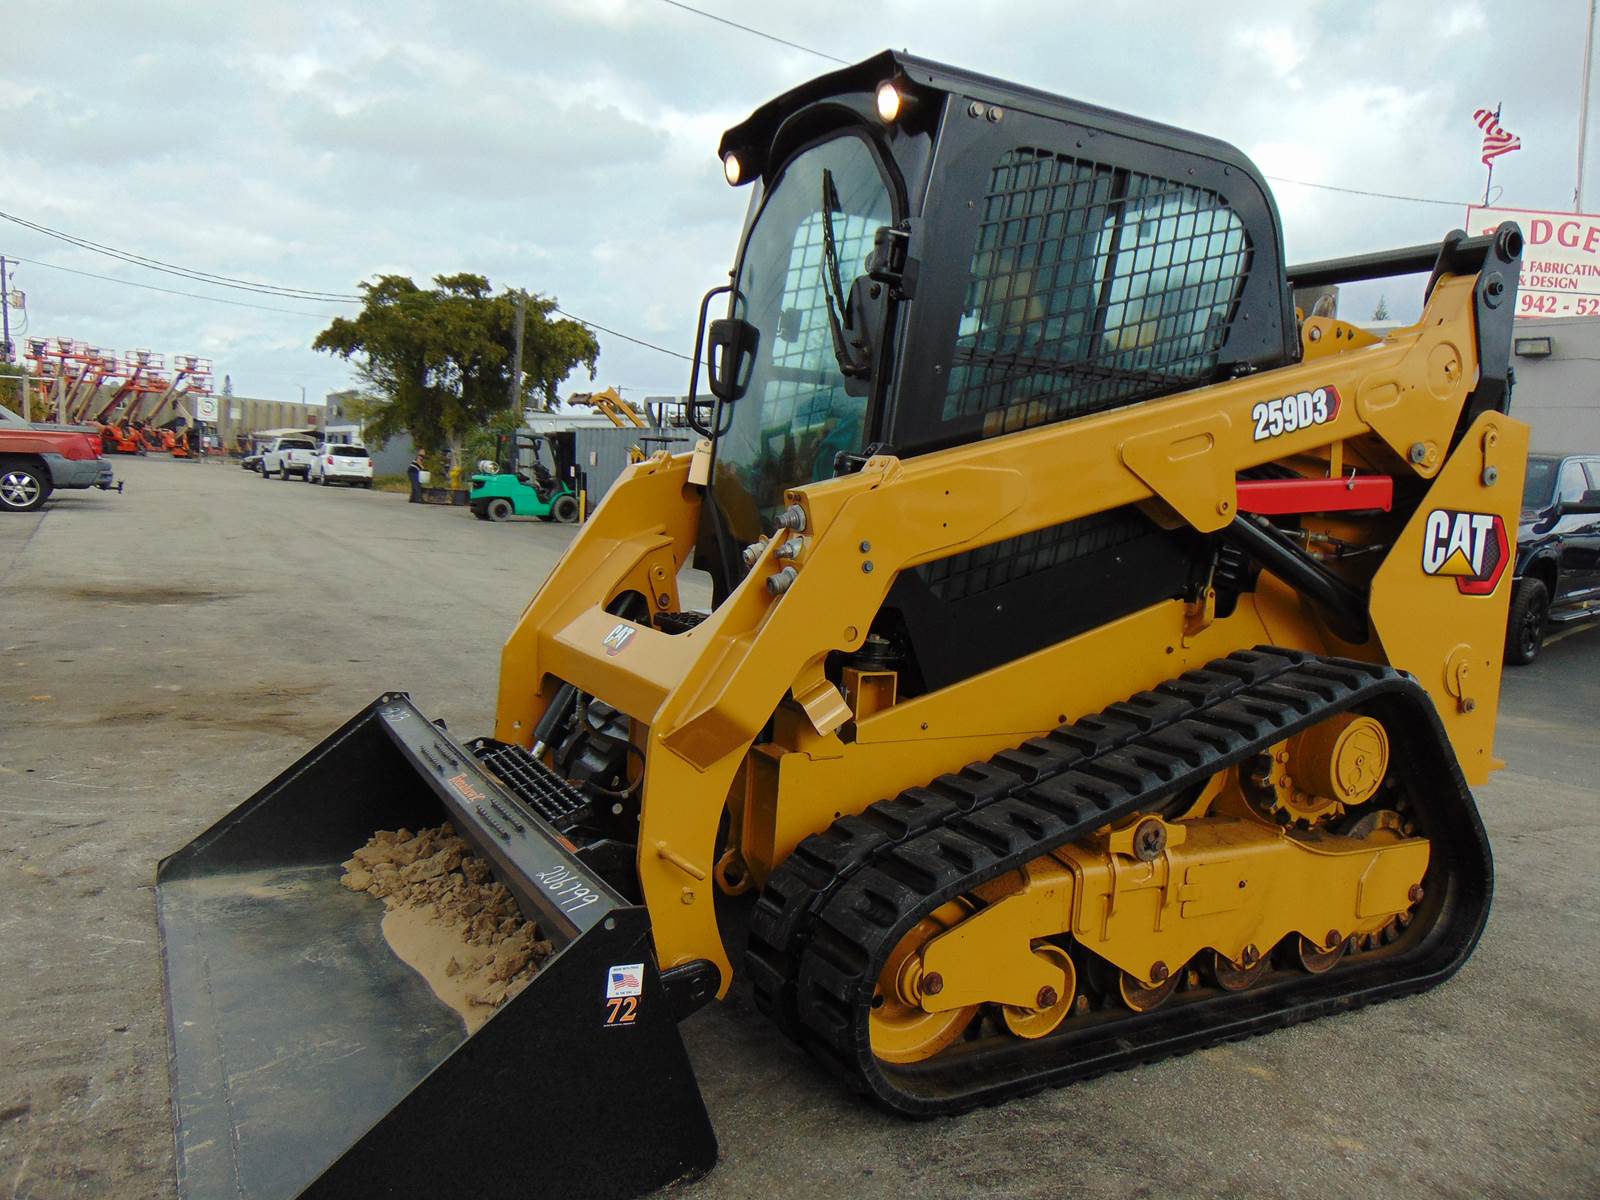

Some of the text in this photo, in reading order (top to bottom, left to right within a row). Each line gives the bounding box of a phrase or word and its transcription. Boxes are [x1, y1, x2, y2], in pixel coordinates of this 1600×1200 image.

[1530, 275, 1579, 289] DESIGN
[1521, 295, 1557, 313] 942
[1252, 387, 1328, 441] 259D3
[1423, 510, 1494, 576] CAT
[603, 623, 636, 649] CAT
[606, 996, 637, 1024] 72
